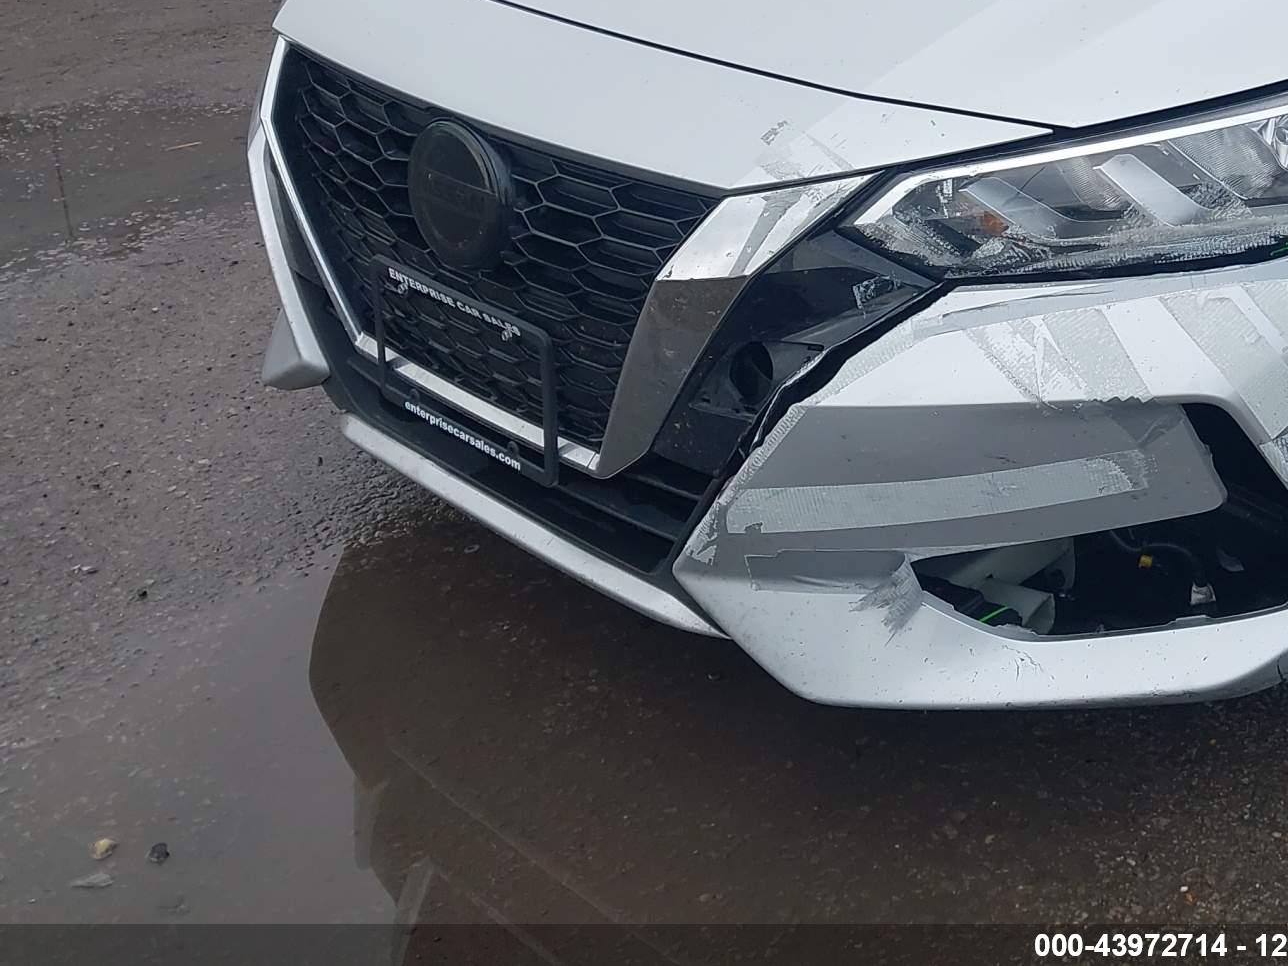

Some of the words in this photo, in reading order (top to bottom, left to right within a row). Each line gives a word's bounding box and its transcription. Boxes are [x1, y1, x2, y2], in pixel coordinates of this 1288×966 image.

[388, 267, 456, 308] ENTERPRISE
[456, 300, 482, 320] CAR
[482, 313, 521, 337] SALES
[404, 400, 521, 472] enterprisecarsales.com
